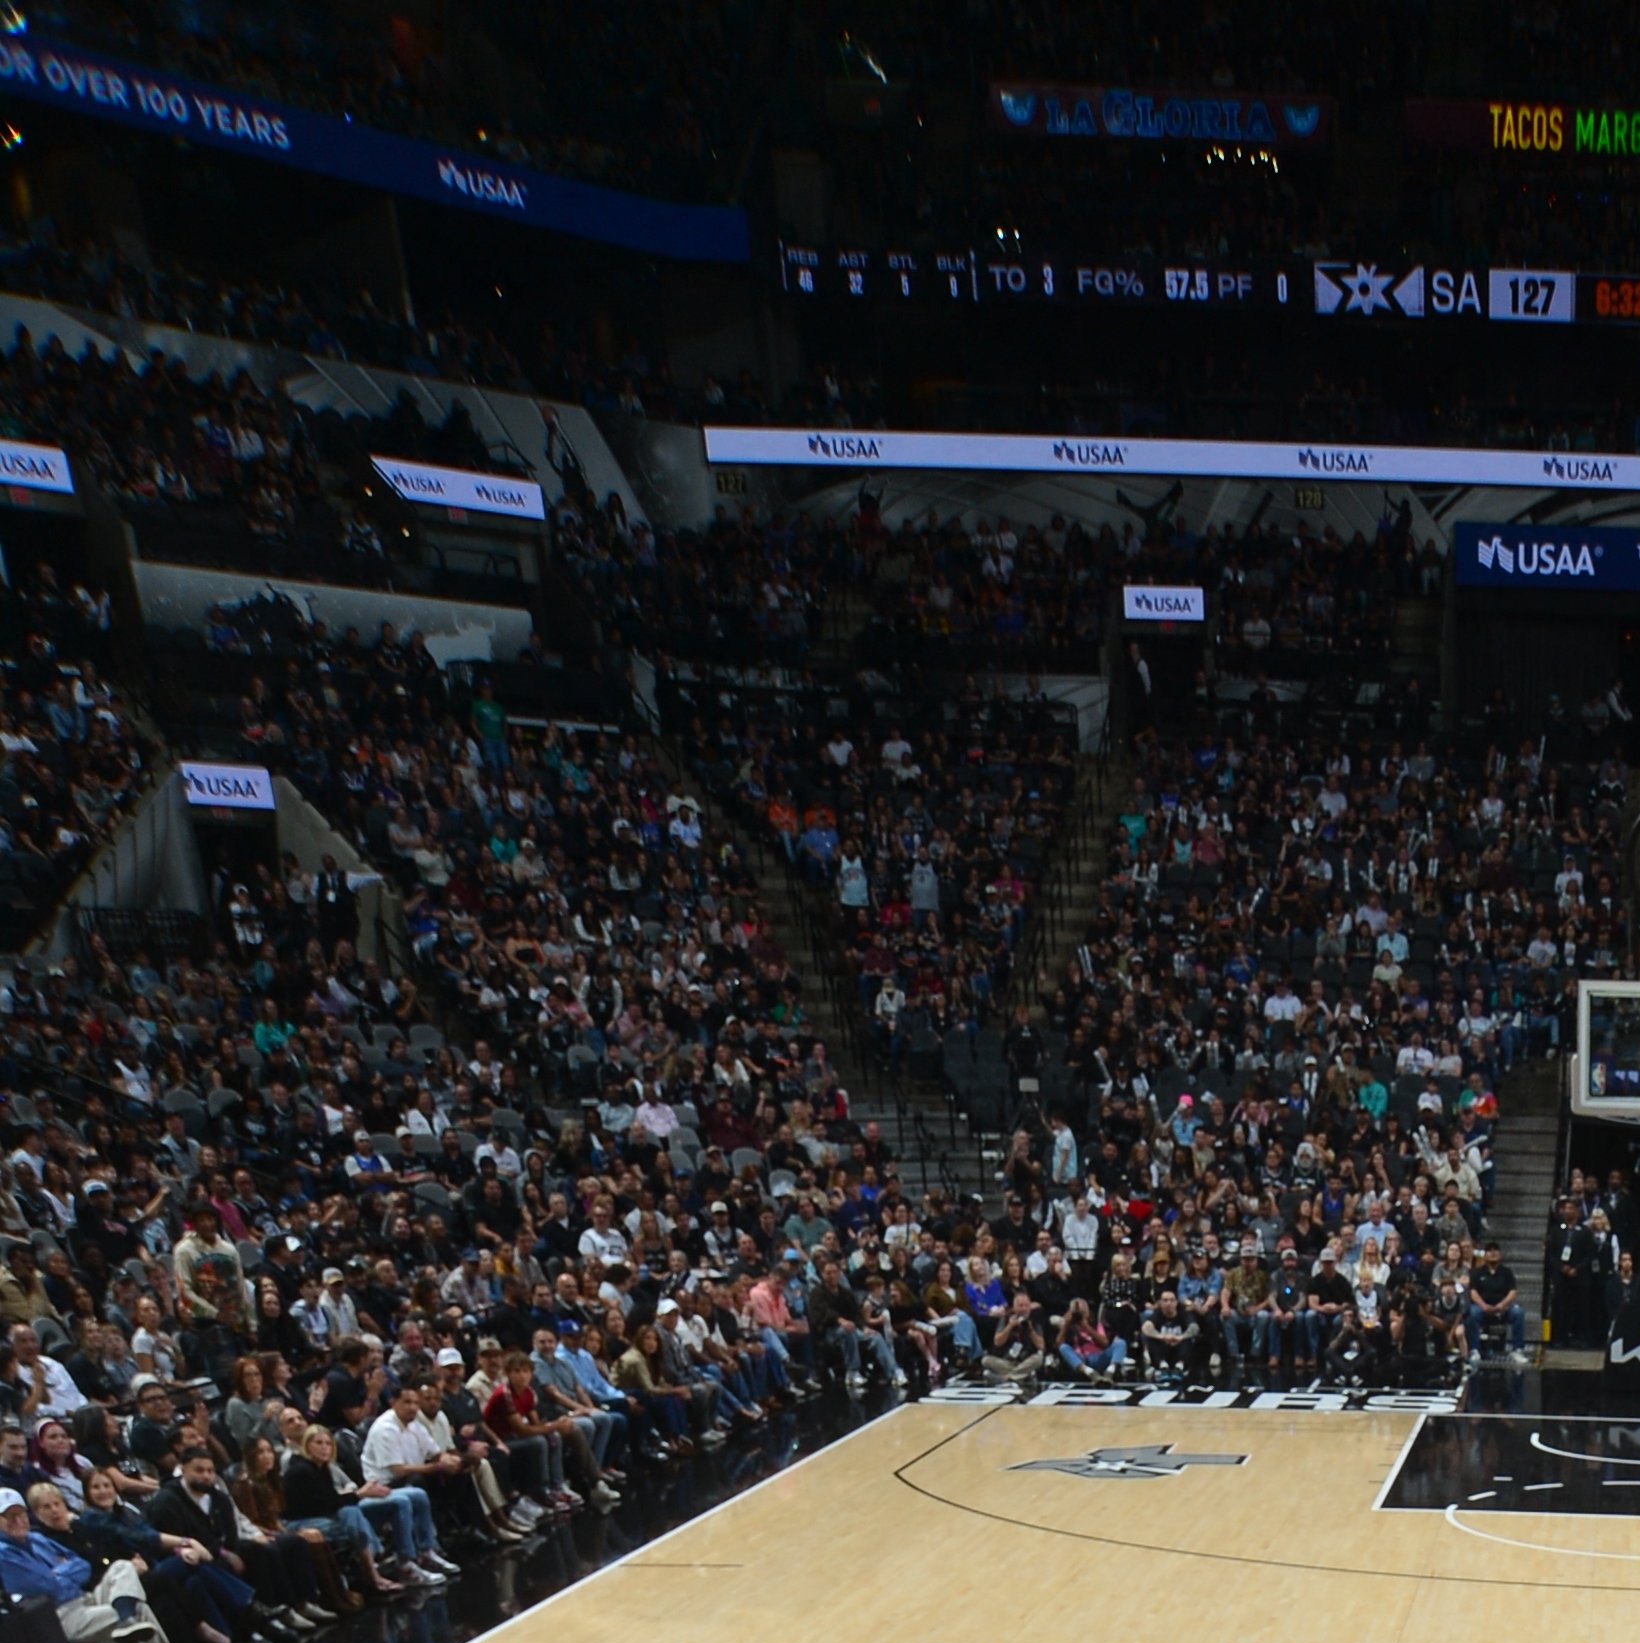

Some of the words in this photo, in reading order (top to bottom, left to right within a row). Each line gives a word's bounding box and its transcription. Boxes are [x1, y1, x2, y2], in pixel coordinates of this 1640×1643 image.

[0, 40, 38, 85] OR
[41, 51, 131, 109] OVER
[132, 78, 190, 123] 100
[194, 93, 292, 152] YEARS
[1101, 87, 1277, 142] GLORIA
[1489, 104, 1564, 152] TACOS
[466, 166, 526, 211] USAA
[786, 247, 820, 268] REB
[838, 250, 869, 269] AST
[888, 253, 919, 272] STL
[936, 254, 968, 273] BLK
[988, 263, 1027, 293] TO
[1042, 263, 1055, 297] 3
[1076, 266, 1145, 298] FG%
[1164, 265, 1211, 301] 57.5
[1217, 271, 1254, 300] PF
[1431, 271, 1482, 316] SA
[1508, 277, 1558, 317] 127
[832, 438, 880, 460] USAA
[1077, 444, 1124, 466] USAA
[1323, 450, 1370, 474] USAA
[1566, 459, 1614, 483] USAA
[409, 474, 446, 496] USAA
[491, 487, 527, 509] USAA
[1516, 543, 1596, 577] USAA
[1154, 598, 1192, 613] USAA
[206, 776, 258, 799] USAA
[918, 1387, 1459, 1413] SPURS
